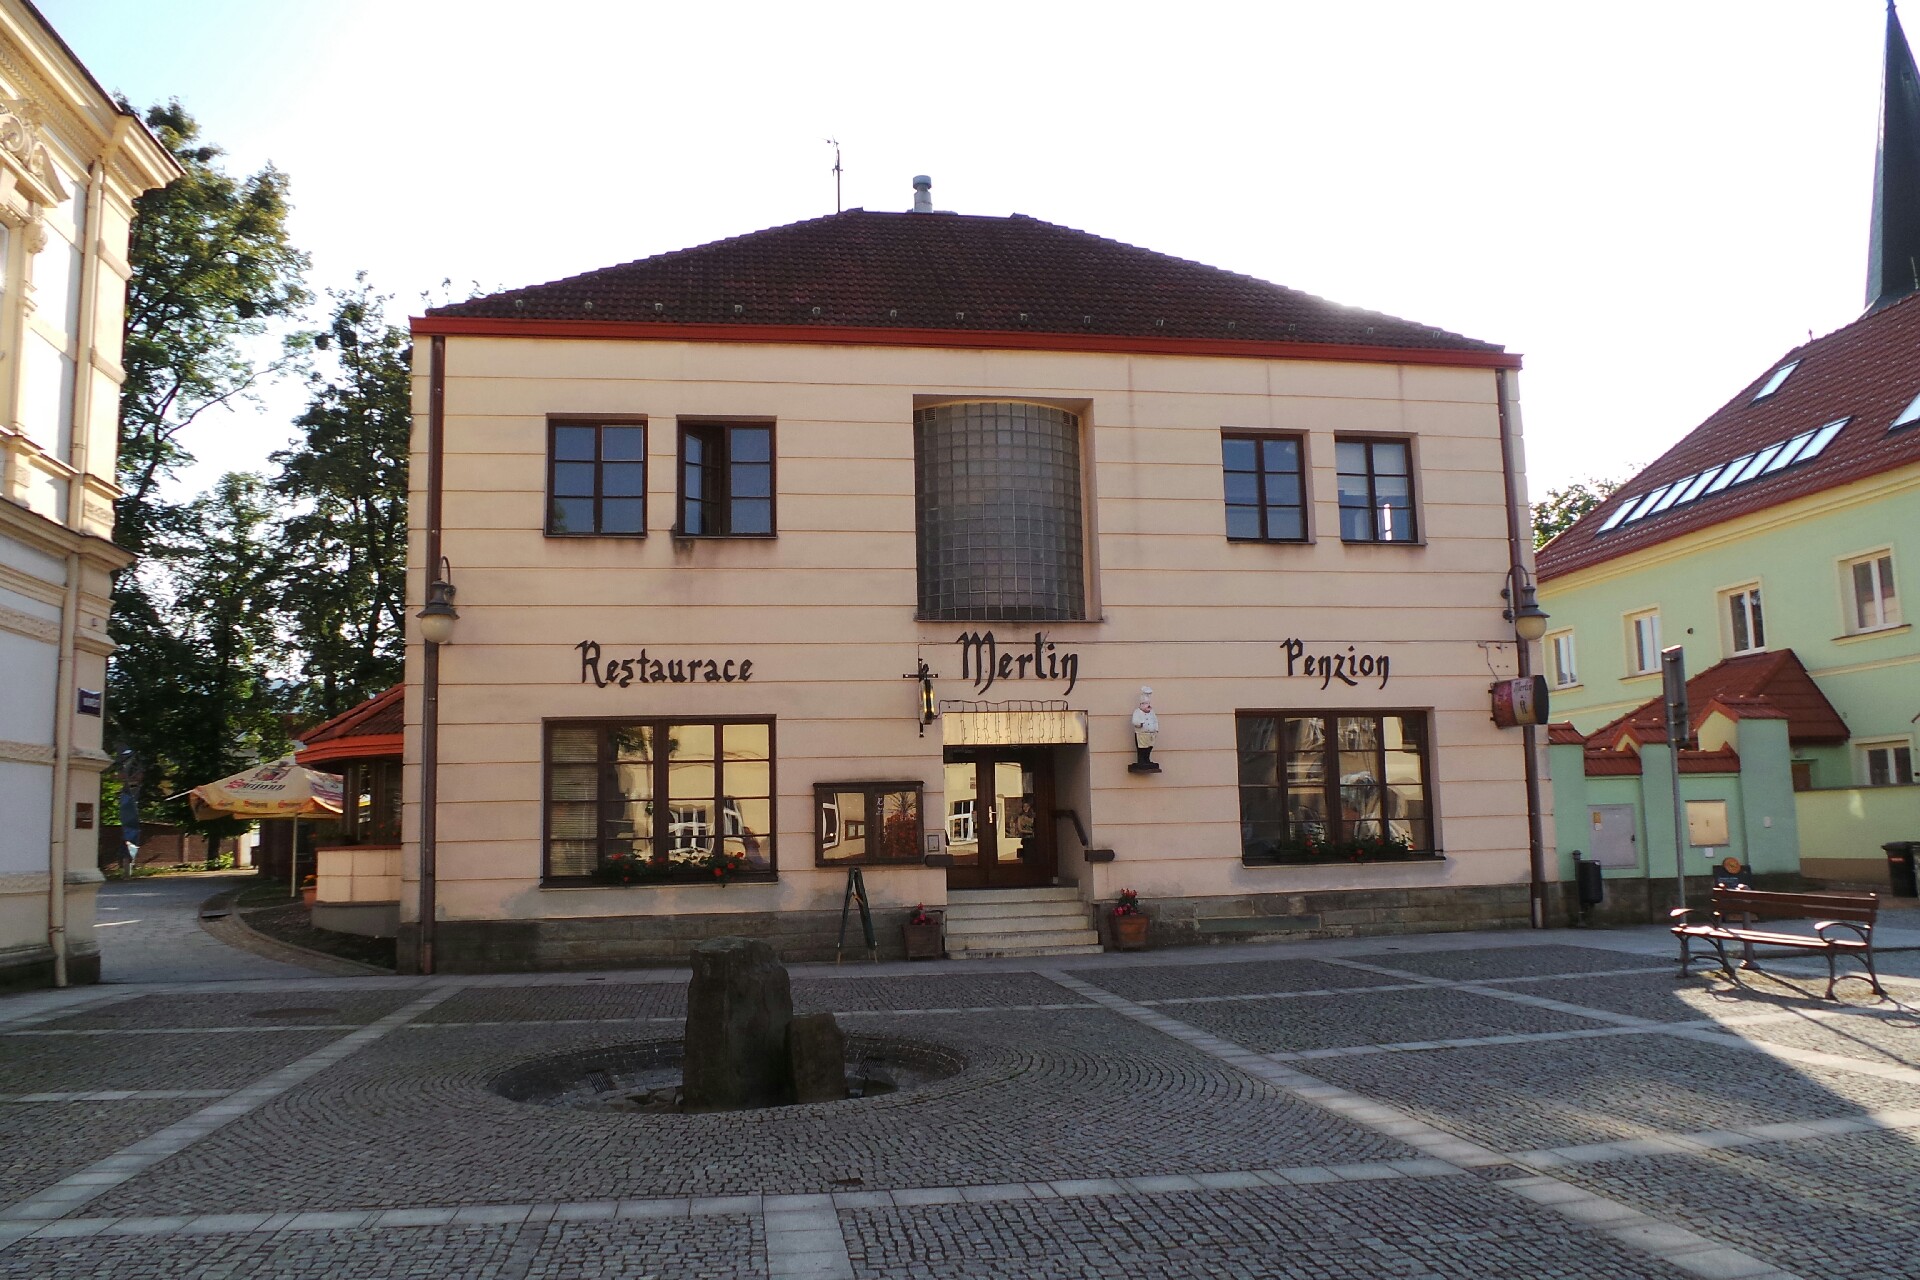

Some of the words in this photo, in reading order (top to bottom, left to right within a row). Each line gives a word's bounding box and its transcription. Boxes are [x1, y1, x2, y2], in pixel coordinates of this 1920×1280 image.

[575, 640, 753, 688] Restaurace
[959, 630, 1079, 695] Merlin
[1280, 638, 1390, 690] Penzion
